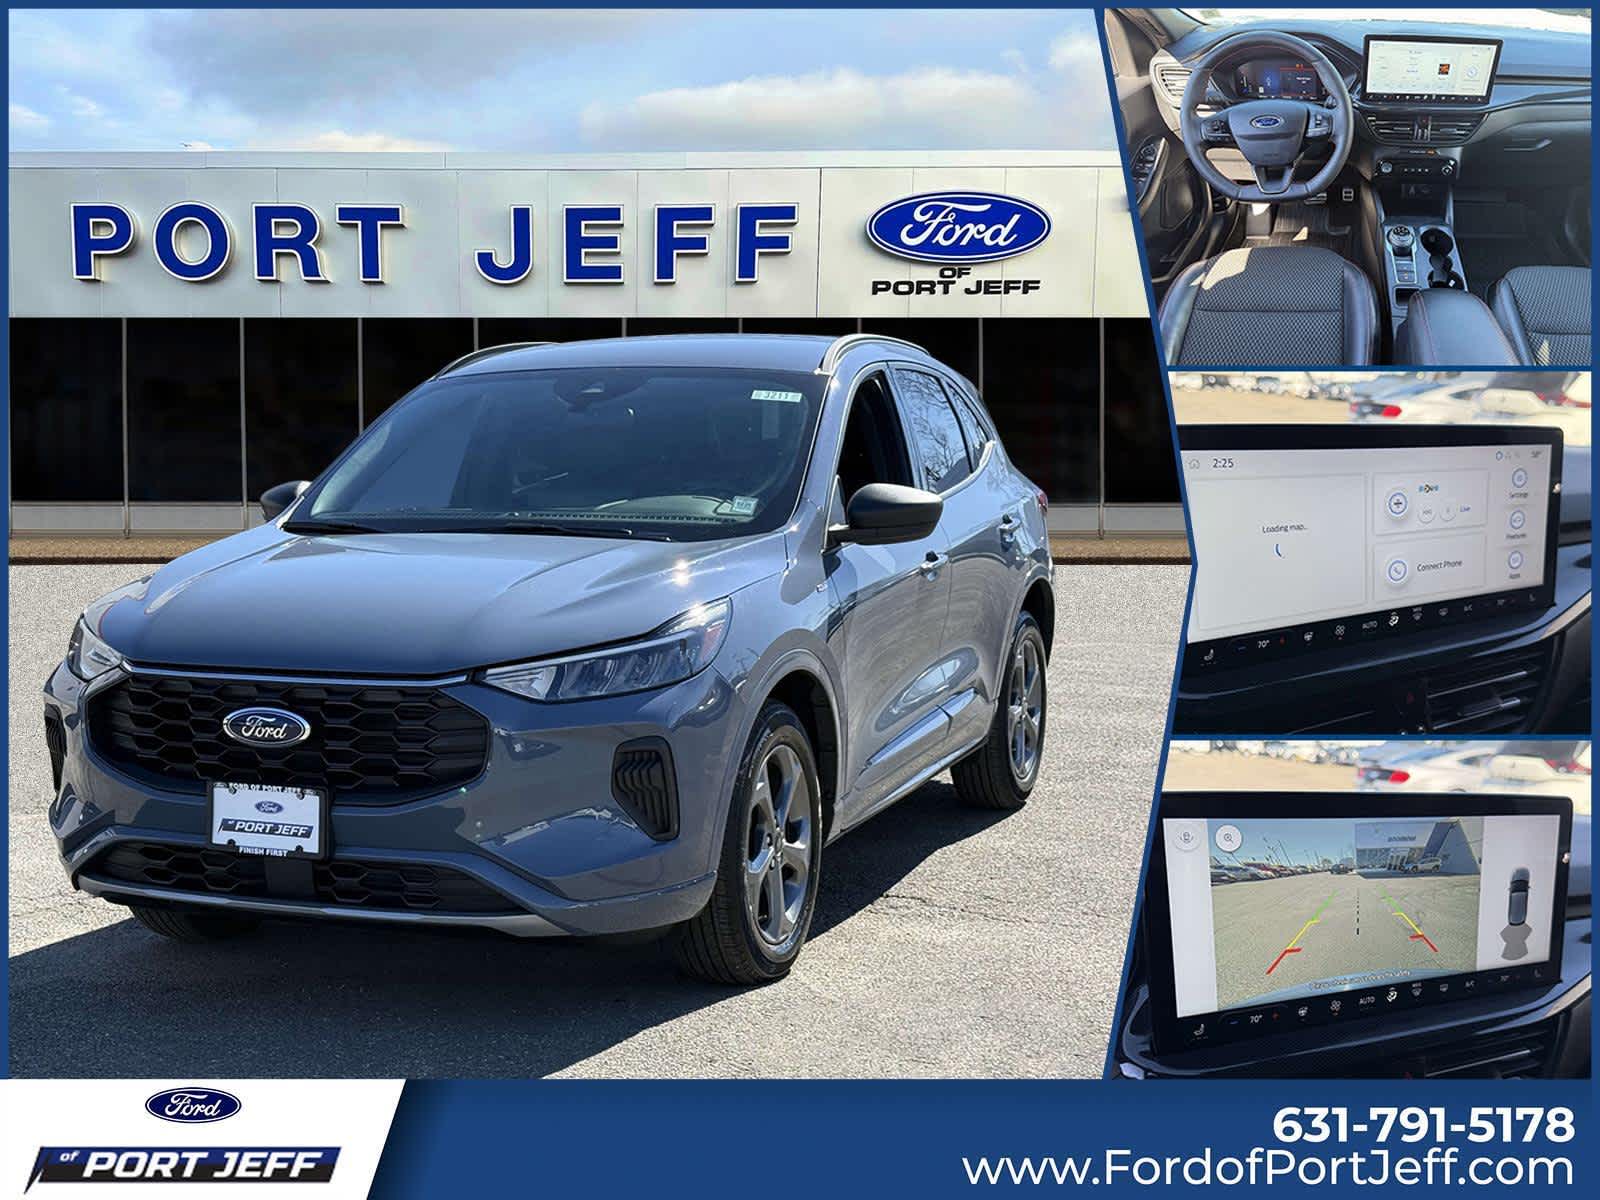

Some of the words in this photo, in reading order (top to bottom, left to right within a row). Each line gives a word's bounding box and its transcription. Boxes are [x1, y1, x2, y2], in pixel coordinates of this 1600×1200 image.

[899, 200, 1021, 247] Ford
[70, 201, 404, 283] PORT
[474, 202, 799, 284] JEFF
[938, 267, 971, 279] OF
[871, 280, 957, 296] PORT
[964, 279, 1041, 295] JEFF
[1212, 458, 1235, 469] 2:25
[1261, 524, 1289, 535] Loading
[1416, 561, 1443, 573] Connect
[1443, 559, 1463, 569] Phone
[1362, 620, 1378, 630] AUTO
[240, 714, 288, 740] Ford
[235, 821, 274, 834] PORT
[274, 824, 309, 837] JEFF
[239, 846, 265, 856] FINISH
[265, 848, 289, 858] FIRST
[1359, 995, 1376, 1005] AUTO
